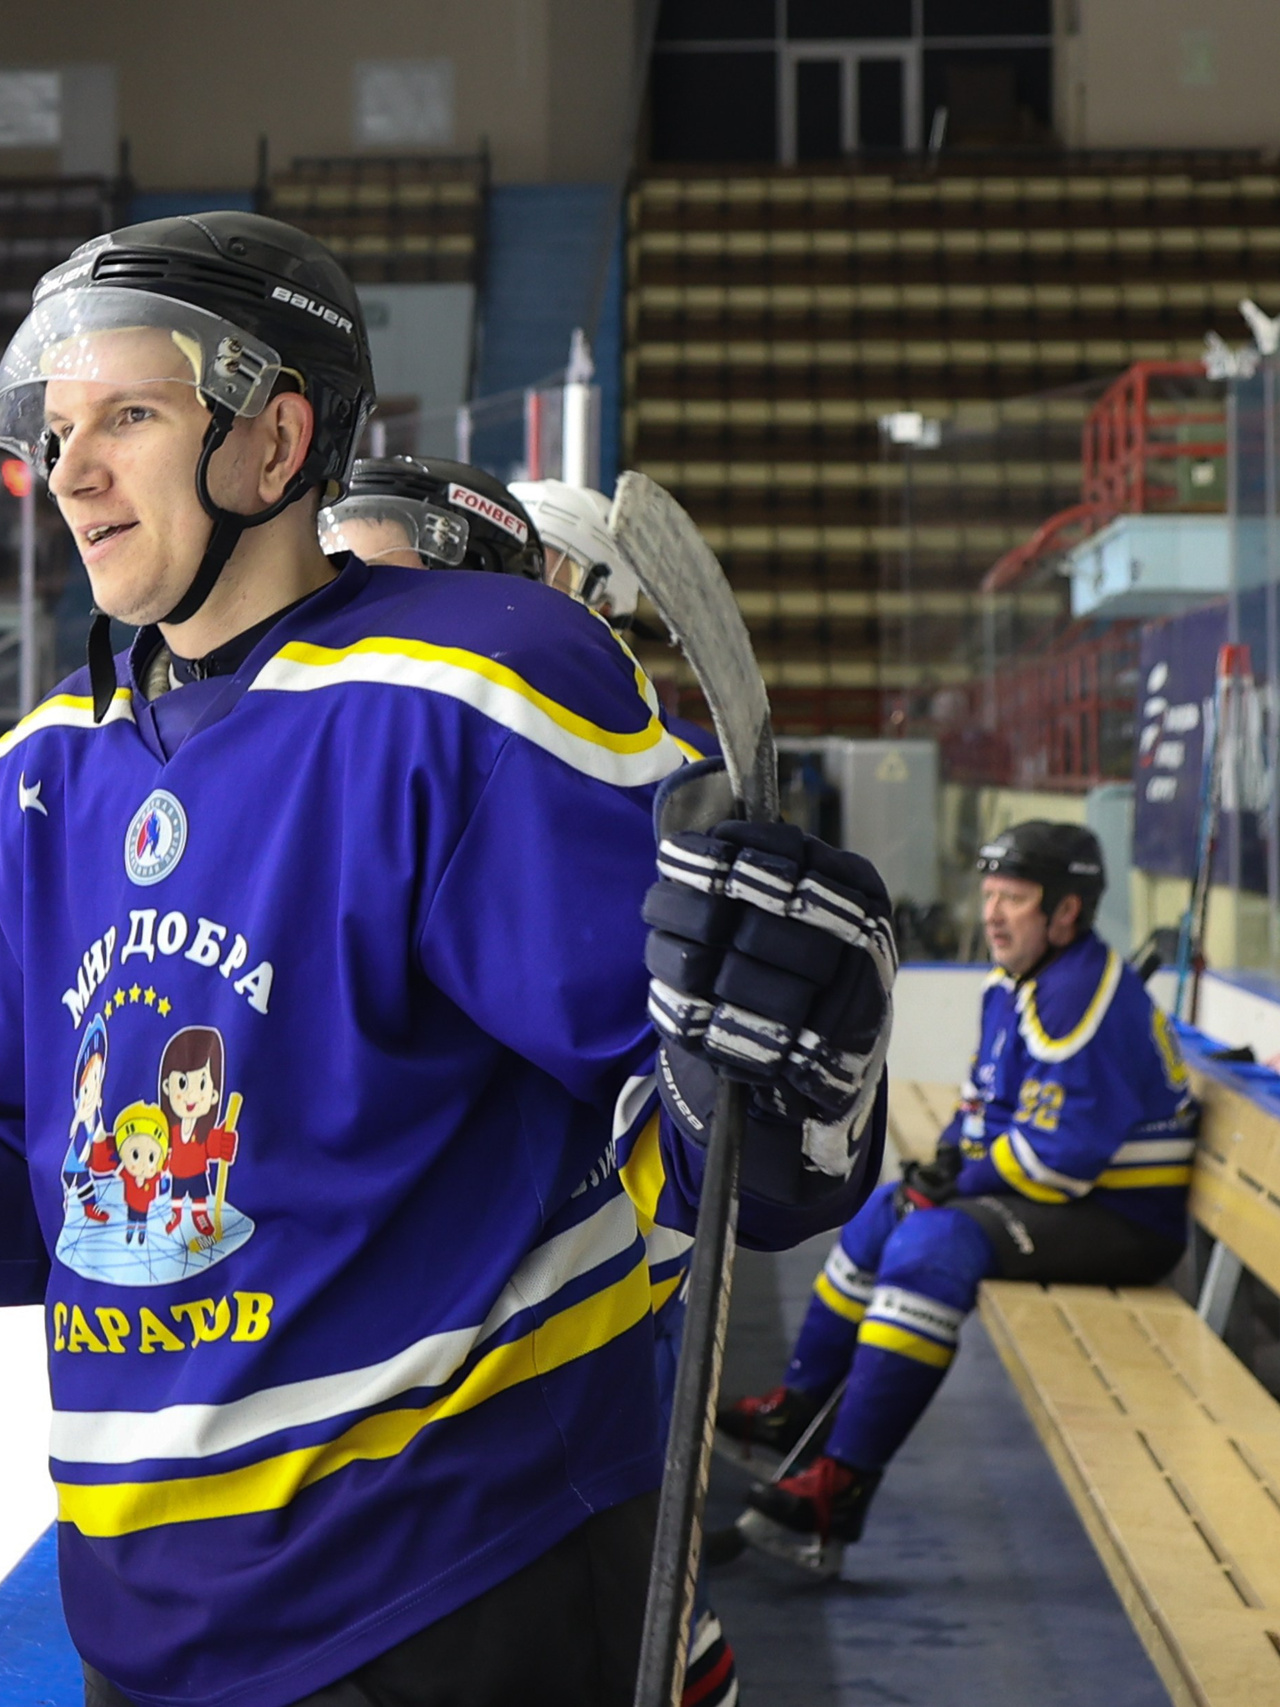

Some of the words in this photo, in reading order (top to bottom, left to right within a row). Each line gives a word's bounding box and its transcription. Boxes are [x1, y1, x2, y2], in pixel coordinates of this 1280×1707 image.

[271, 286, 353, 334] BAUER
[452, 488, 526, 534] FONBET
[61, 925, 117, 1030] МИР
[121, 908, 274, 1014] ДОБРА
[659, 1048, 705, 1131] BAUER
[53, 1291, 274, 1354] САРАТОВ
